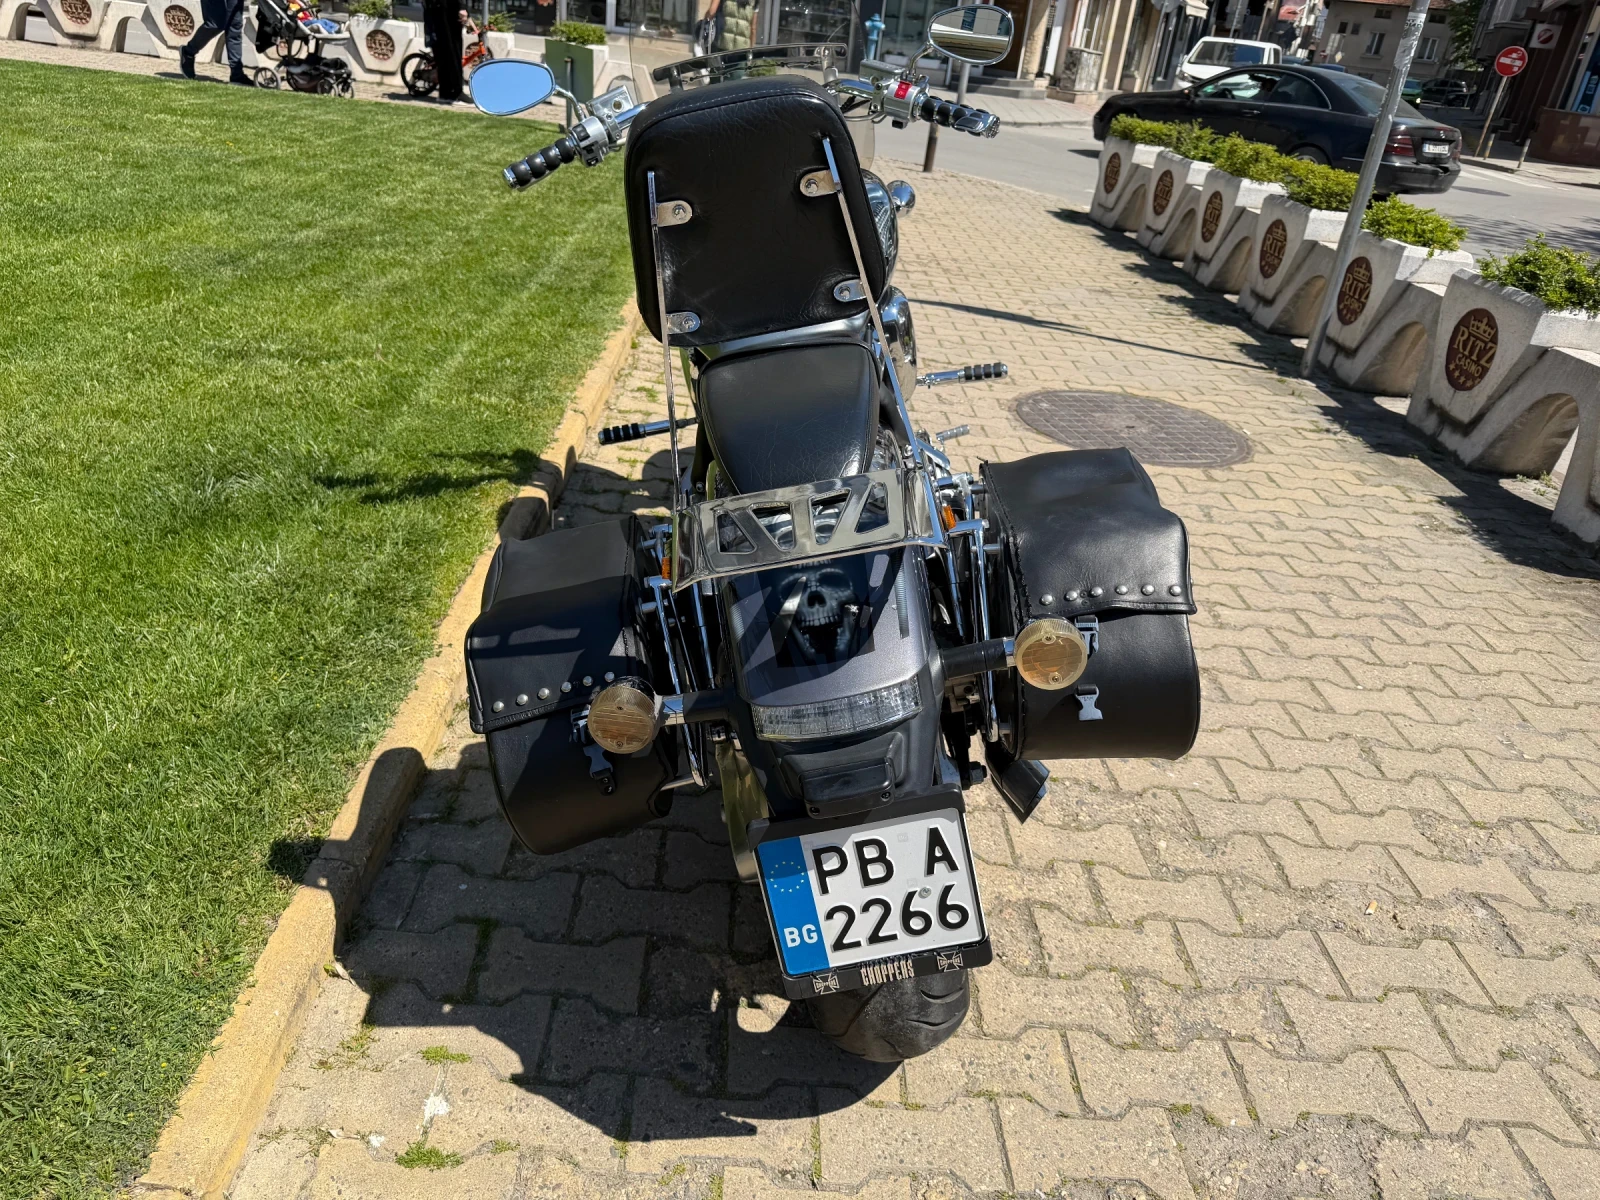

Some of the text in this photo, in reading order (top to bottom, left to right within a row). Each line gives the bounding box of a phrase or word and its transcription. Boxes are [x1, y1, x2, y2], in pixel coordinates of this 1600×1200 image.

[165, 12, 194, 27] RITZ
[1263, 234, 1287, 258] RITZ
[1342, 273, 1372, 303] RITZ
[1345, 295, 1363, 312] CASINO
[1453, 325, 1498, 369] RITZ
[1455, 353, 1482, 377] CASINO
[812, 827, 959, 896] PB A
[825, 883, 970, 952] 2266
[784, 924, 819, 948] BG
[860, 959, 915, 986] CHOPPERS
